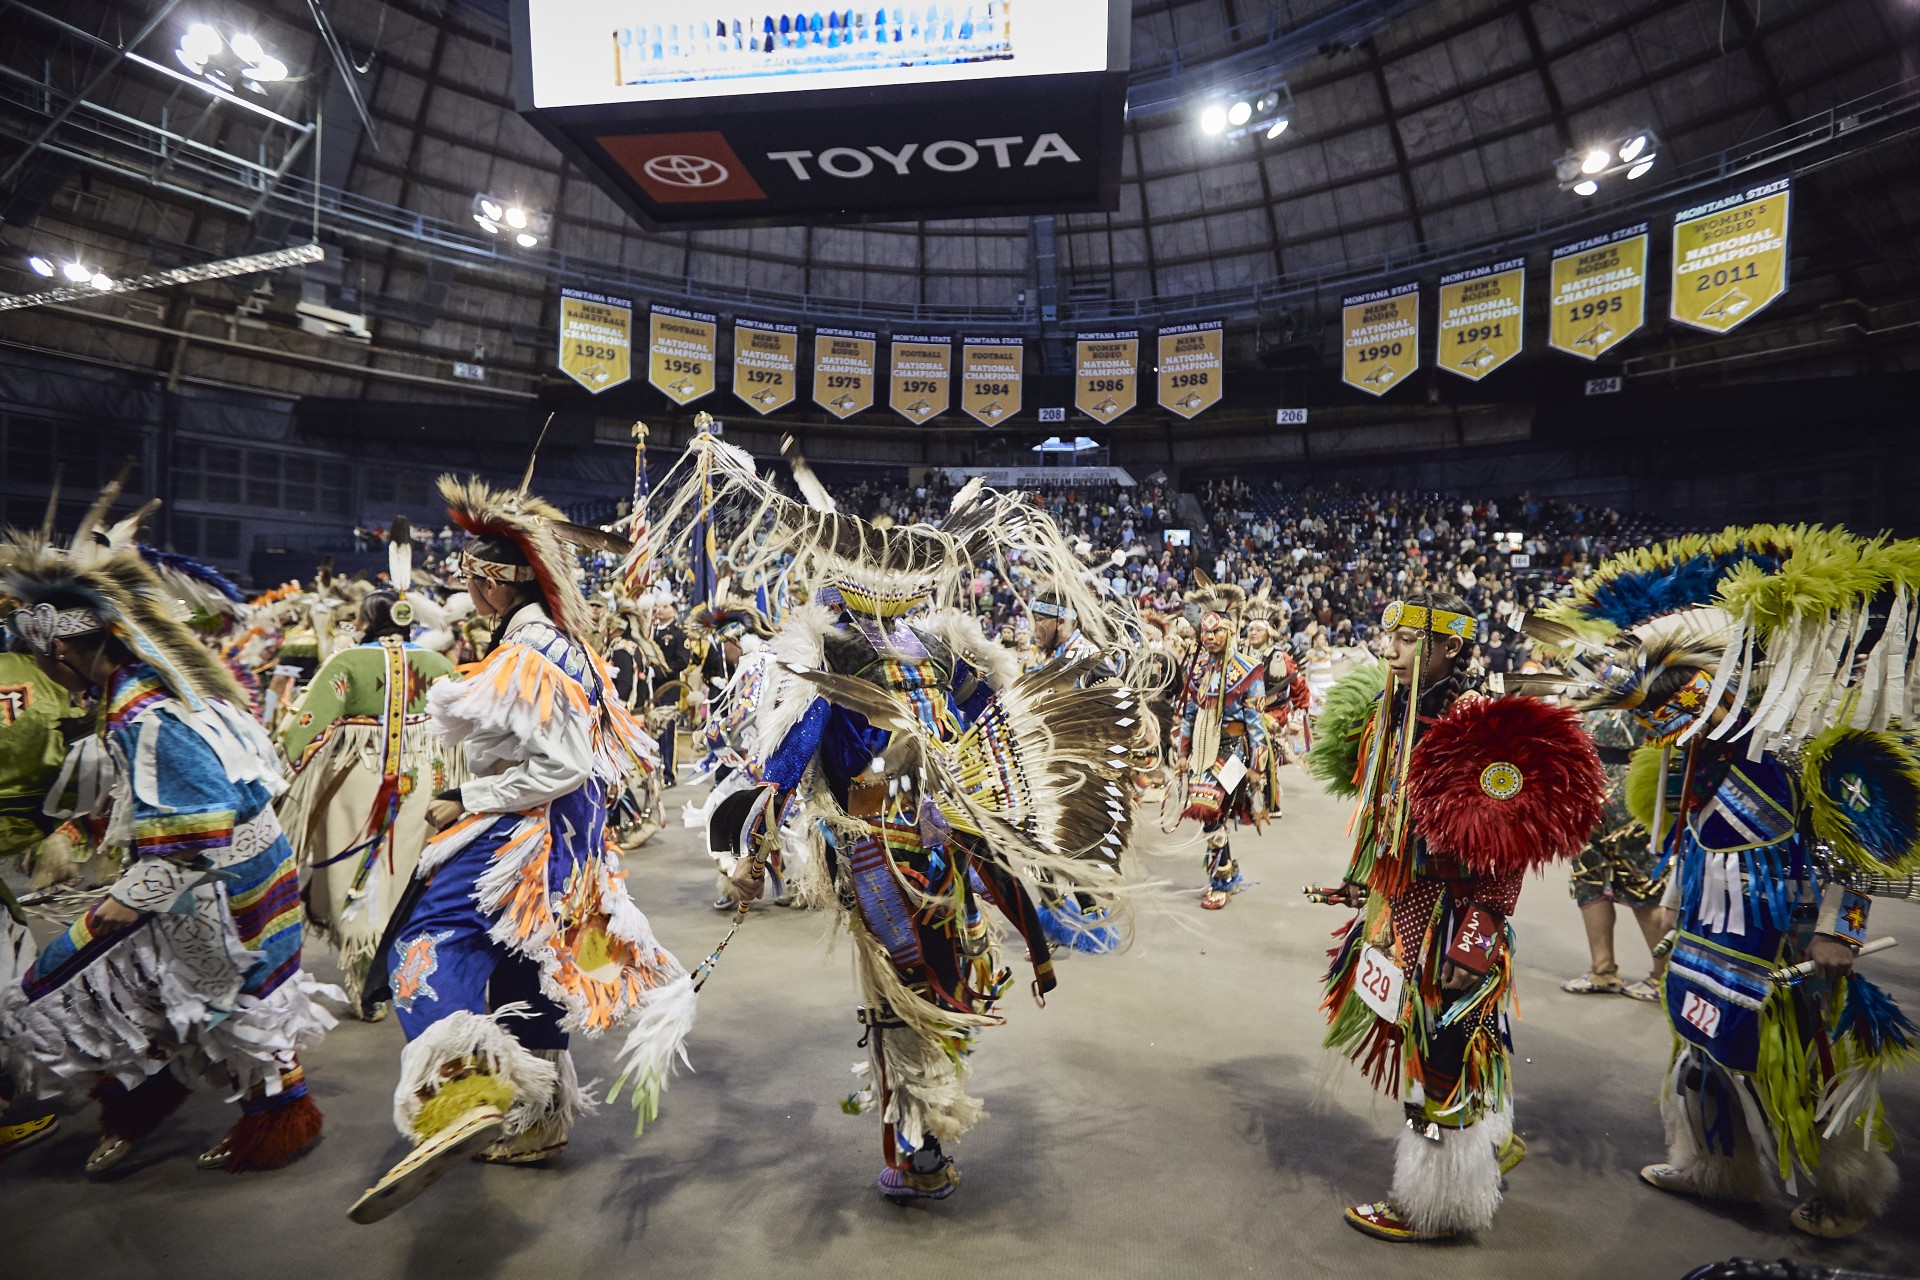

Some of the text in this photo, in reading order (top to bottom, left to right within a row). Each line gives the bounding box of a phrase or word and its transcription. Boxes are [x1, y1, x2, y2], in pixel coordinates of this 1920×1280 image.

[768, 133, 1081, 180] TOYOTA
[1675, 178, 1790, 222] MONTANA STATE
[1695, 204, 1767, 234] WOMEN'S
[1703, 218, 1756, 242] RODEO
[1552, 222, 1649, 258] MONTANA STATE
[1684, 227, 1774, 262] NATIONAL
[1578, 248, 1618, 266] MEN'S
[1677, 238, 1782, 274] CHAMPIONS
[1440, 257, 1525, 285] MONTANA STATE
[1575, 257, 1621, 276] RODEO
[1561, 266, 1636, 294] NATIONAL
[1696, 262, 1759, 292] 2011
[1343, 281, 1419, 306] MONTANA STATE
[1464, 279, 1498, 293] MEN'S
[1553, 276, 1641, 306] CHAMPIONS
[561, 288, 632, 308] MONTANA STATE
[1461, 288, 1501, 303] RODEO
[651, 304, 717, 322] MONTANA STATE
[1365, 302, 1397, 314] MEN'S
[1448, 297, 1513, 318] NATIONAL
[1570, 296, 1623, 323] 1995
[1362, 309, 1398, 324] RODEO
[1441, 305, 1520, 329] CHAMPIONS
[569, 320, 624, 338] NATIONAL
[660, 322, 707, 336] FOOTBALL
[735, 318, 798, 332] MONTANA STATE
[1158, 321, 1223, 335] MONTANA STATE
[1351, 318, 1410, 337] NATIONAL
[563, 328, 629, 347] CHAMPIONS
[816, 327, 876, 339] MONTANA STATE
[892, 334, 929, 342] MONTANA
[1077, 331, 1115, 340] MONTANA
[1176, 335, 1204, 345] MEN'S
[1346, 327, 1416, 347] CHAMPIONS
[1457, 323, 1503, 345] 1991
[658, 337, 709, 352] NATIONAL
[1088, 343, 1128, 352] WOMEN'S
[1175, 343, 1205, 353] RODEO
[1358, 341, 1403, 363] 1990
[576, 344, 616, 361] 1929
[651, 344, 713, 361] CHAMPIONS
[741, 349, 790, 363] NATIONAL
[900, 350, 942, 358] FOOTBALL
[972, 352, 1014, 360] FOOTBALL
[1093, 351, 1122, 359] RODEO
[1165, 352, 1215, 365] NATIONAL
[665, 359, 702, 375] 1956
[736, 356, 794, 371] CHAMPIONS
[822, 356, 868, 367] NATIONAL
[897, 361, 944, 370] NATIONAL
[970, 364, 1016, 372] NATIONAL
[1083, 360, 1131, 368] NATIONAL
[1160, 360, 1220, 373] CHAMPIONS
[817, 364, 873, 375] CHAMPIONS
[893, 370, 949, 378] CHAMPIONS
[965, 372, 1021, 381] CHAMPIONS
[1079, 367, 1136, 377] CHAMPIONS
[747, 370, 783, 385] 1972
[827, 376, 861, 389] 1975
[1171, 373, 1208, 388] 1988
[903, 381, 937, 393] 1976
[975, 383, 1009, 396] 1984
[1088, 379, 1124, 392] 1986
[1590, 379, 1617, 392] 204
[1042, 410, 1061, 420] 208
[1281, 410, 1304, 421] 206
[1362, 959, 1391, 1003] 229
[1686, 995, 1718, 1033] 212
